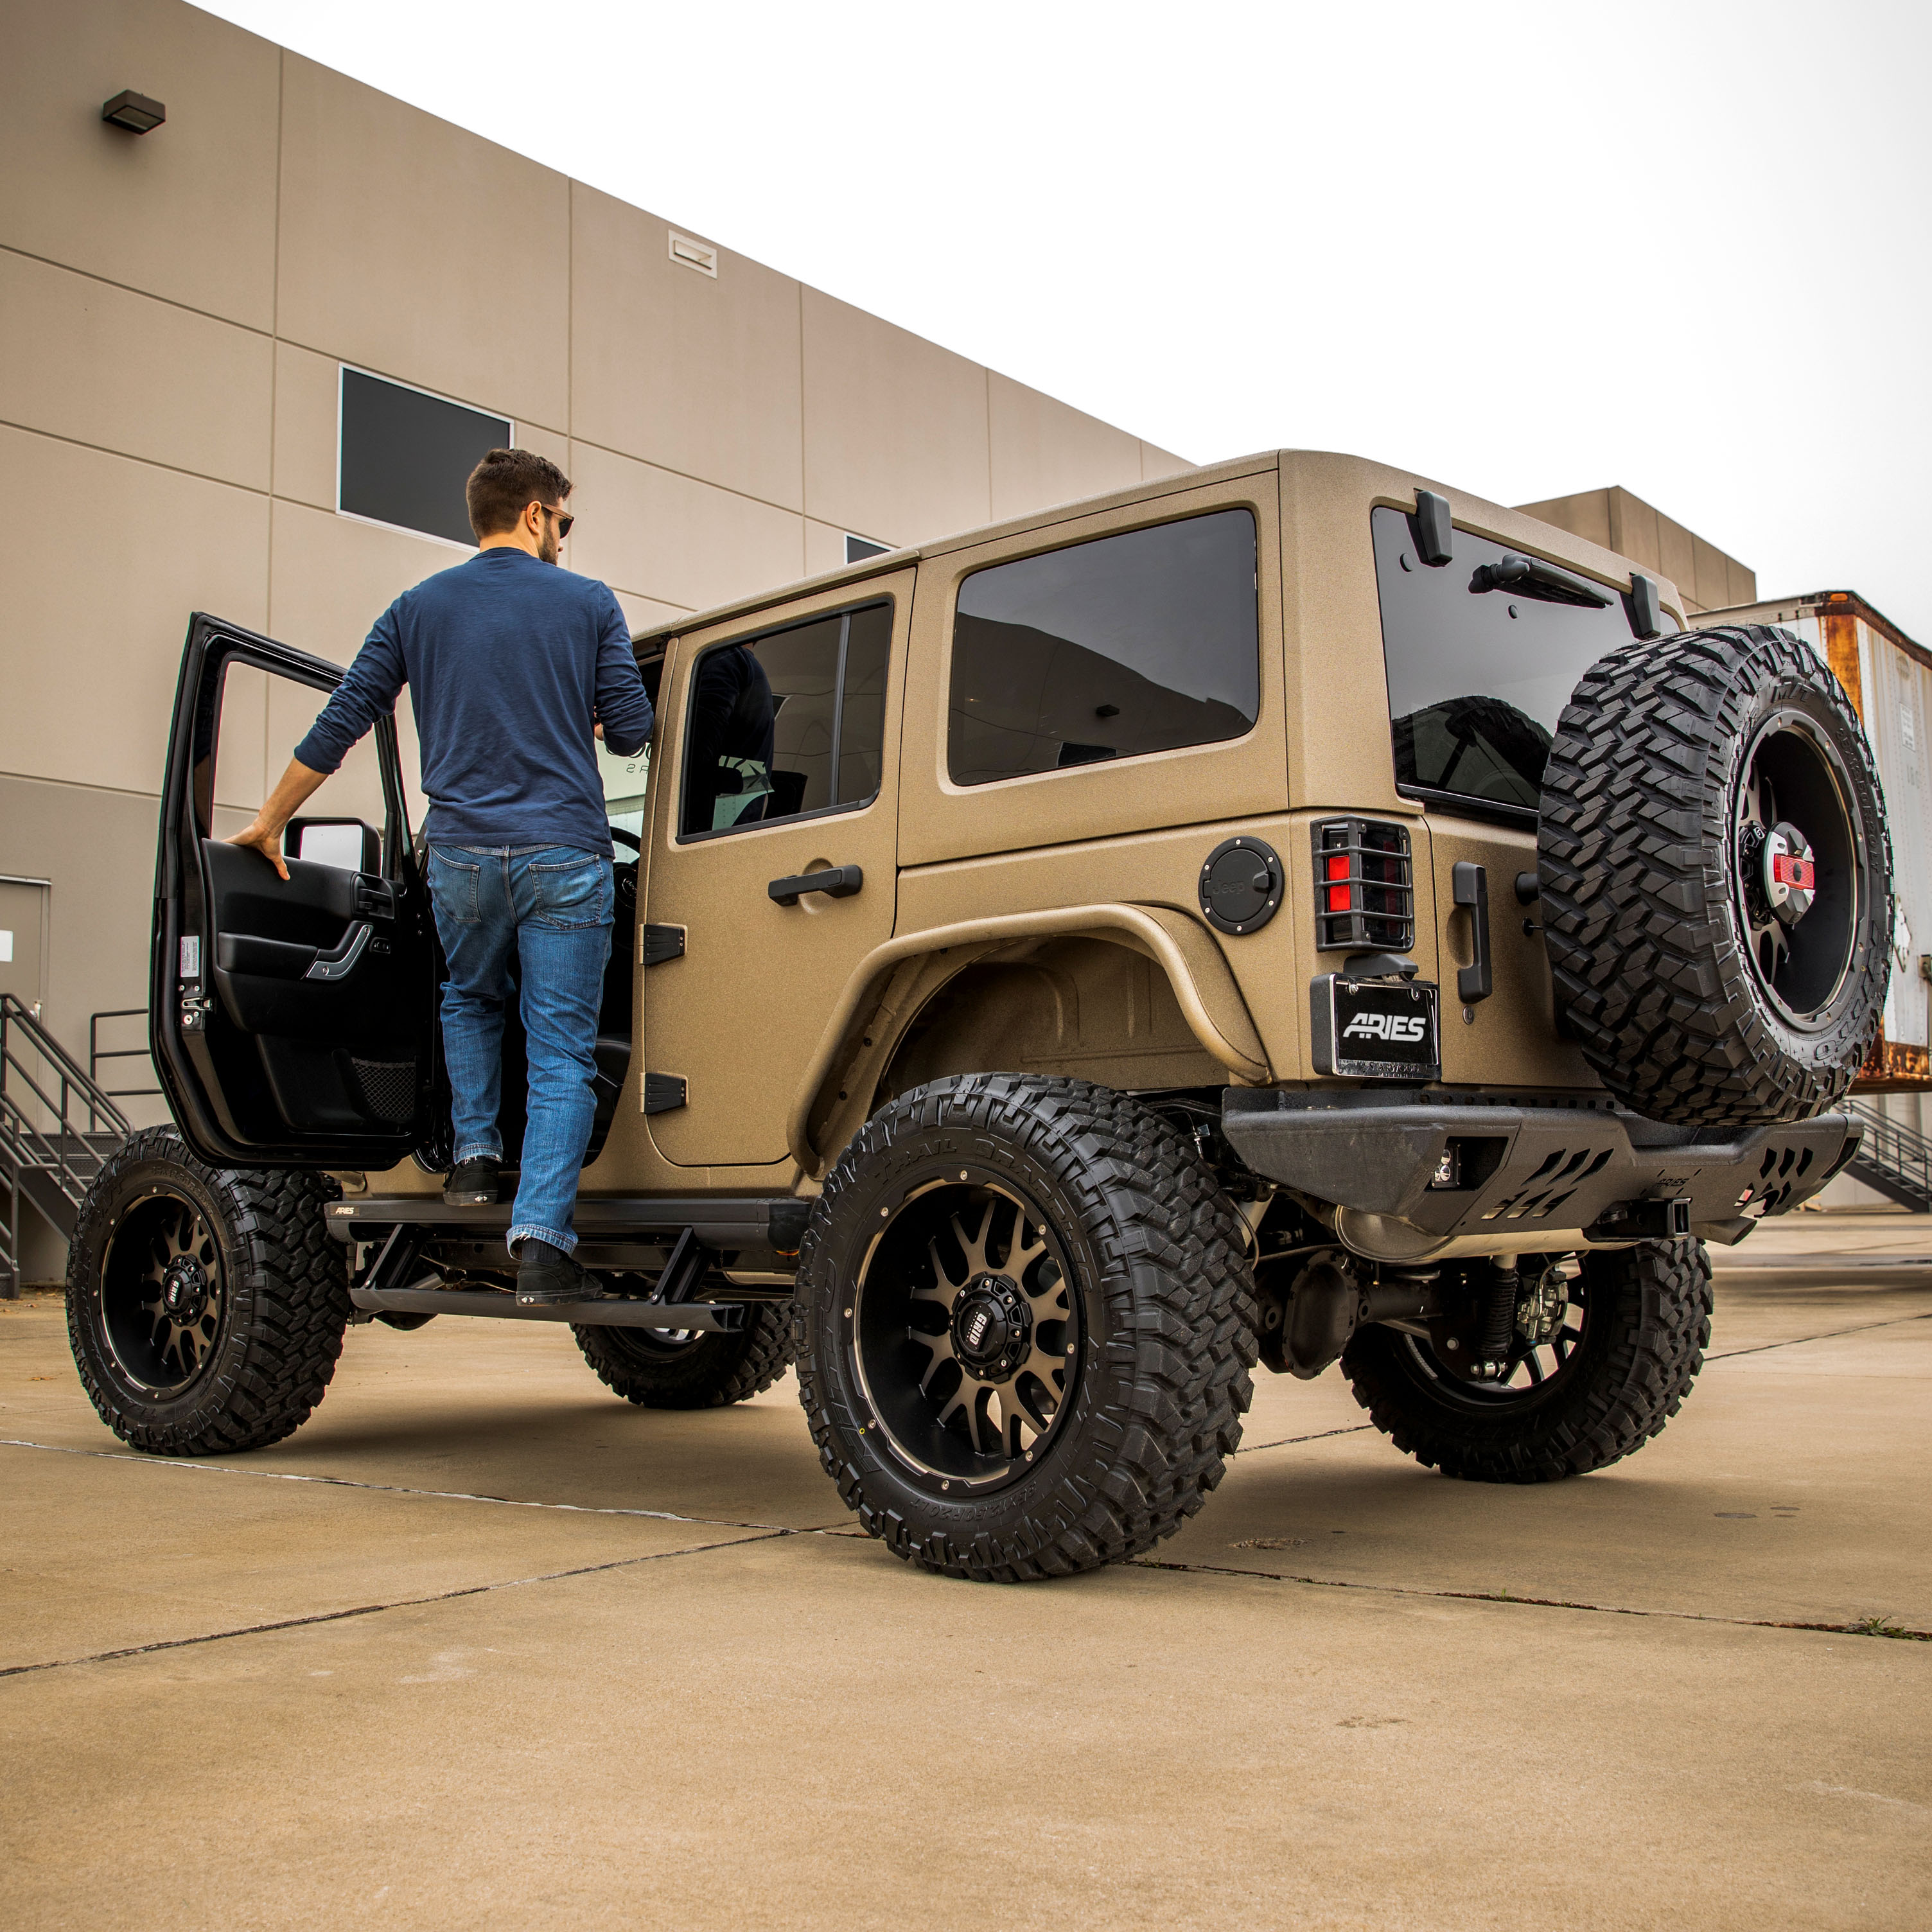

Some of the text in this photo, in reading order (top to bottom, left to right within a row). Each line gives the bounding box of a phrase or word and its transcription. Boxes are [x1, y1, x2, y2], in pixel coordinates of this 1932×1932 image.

[1212, 879, 1245, 895] Jeep
[1342, 1012, 1427, 1042] ARIES
[1369, 1062, 1419, 1073] STARWOOD
[169, 1279, 180, 1303] GRID
[969, 1312, 988, 1346] GRID
